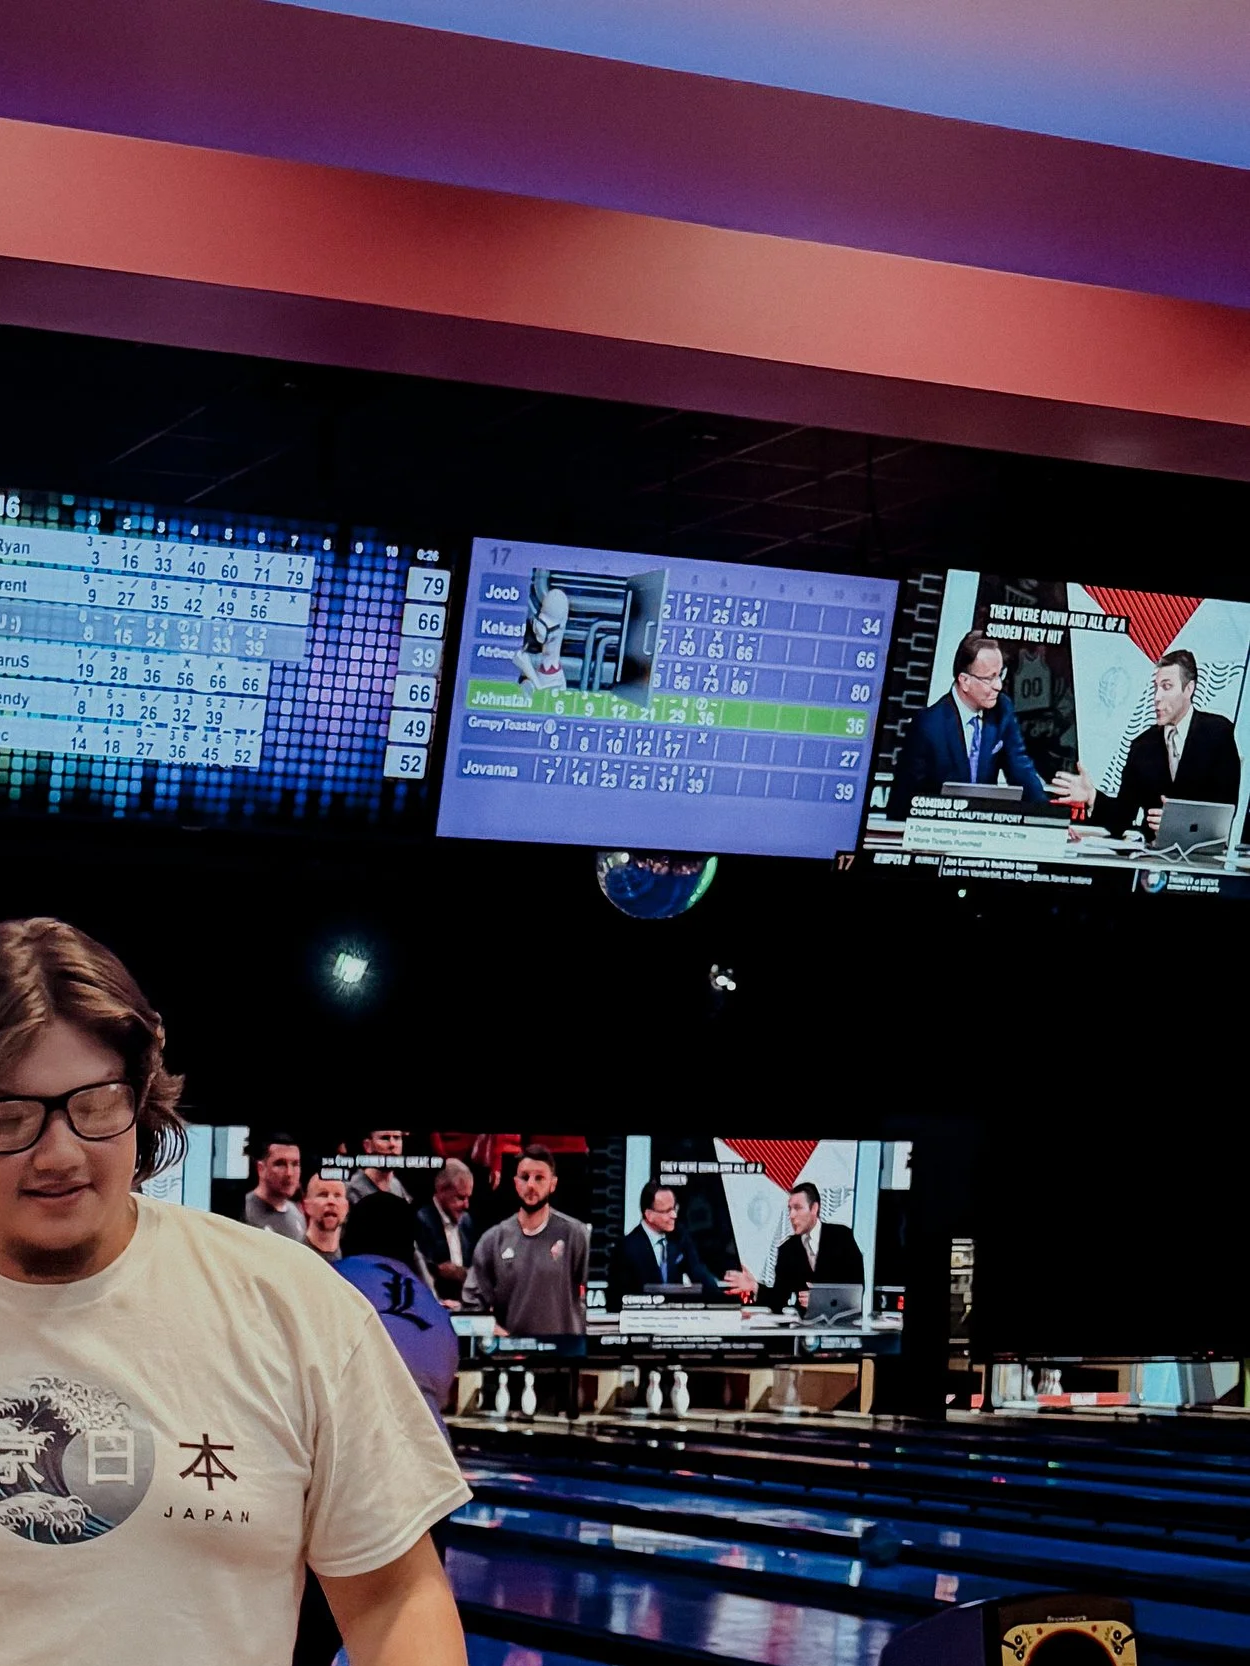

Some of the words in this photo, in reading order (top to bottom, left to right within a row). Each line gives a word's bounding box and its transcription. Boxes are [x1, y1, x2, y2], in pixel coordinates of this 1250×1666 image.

[491, 547, 511, 565] 17
[92, 551, 99, 565] 3
[122, 554, 138, 569] 16
[155, 558, 171, 572] 33
[188, 561, 205, 575] 40
[222, 565, 238, 579] 60
[255, 568, 269, 582] 71
[288, 571, 303, 585] 79
[424, 577, 444, 595] 79
[486, 585, 519, 600] Joob
[862, 618, 880, 635] 34
[990, 604, 1013, 620] THEY
[1014, 607, 1040, 623] WERE
[1041, 610, 1068, 626] DOWN
[1068, 614, 1087, 627] AND
[1088, 616, 1103, 629] ALL
[1105, 617, 1118, 630] OF
[1118, 619, 1125, 632] A
[419, 613, 439, 631] 66
[986, 623, 1022, 640] SUDDEN
[1024, 627, 1046, 642] THEY
[1047, 630, 1063, 644] HIT
[412, 648, 435, 667] 39
[857, 651, 875, 668] 66
[78, 664, 94, 677] 19
[110, 666, 127, 680] 28
[144, 669, 160, 683] 36
[177, 672, 193, 686] 56
[210, 675, 226, 688] 66
[243, 678, 258, 691] 66
[410, 685, 430, 702] 66
[851, 685, 869, 701] 80
[404, 720, 425, 737] 49
[846, 718, 864, 734] 36
[550, 735, 559, 749] 8
[580, 737, 588, 751] 8
[607, 739, 622, 754] 10
[636, 741, 651, 756] 12
[665, 744, 680, 758] 17
[840, 751, 859, 767] 27
[400, 755, 421, 772] 52
[546, 769, 555, 784] 7
[572, 771, 588, 785] 14
[600, 773, 617, 788] 23
[629, 775, 646, 789] 23
[658, 777, 674, 791] 31
[687, 779, 704, 793] 39
[835, 783, 853, 800] 39
[838, 855, 855, 870] 17
[163, 1505, 251, 1524] JAPAN
